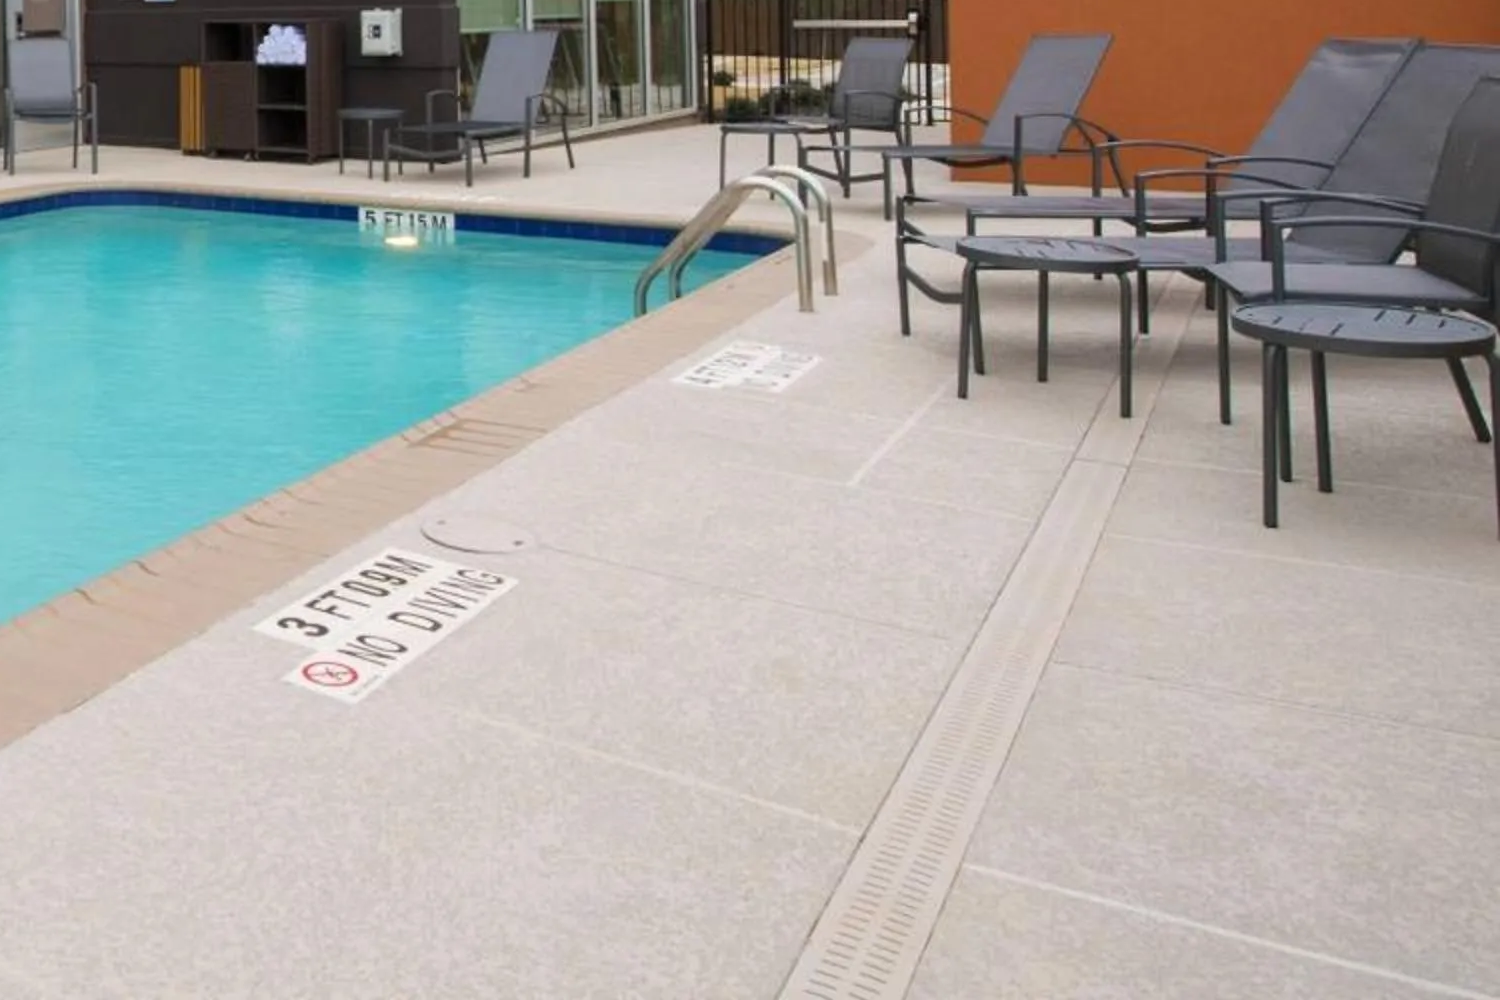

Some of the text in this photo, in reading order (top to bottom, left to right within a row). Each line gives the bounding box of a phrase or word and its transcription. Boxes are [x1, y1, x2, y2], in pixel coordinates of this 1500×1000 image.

[277, 617, 330, 638] 3
[336, 568, 505, 667] NO DIVING
